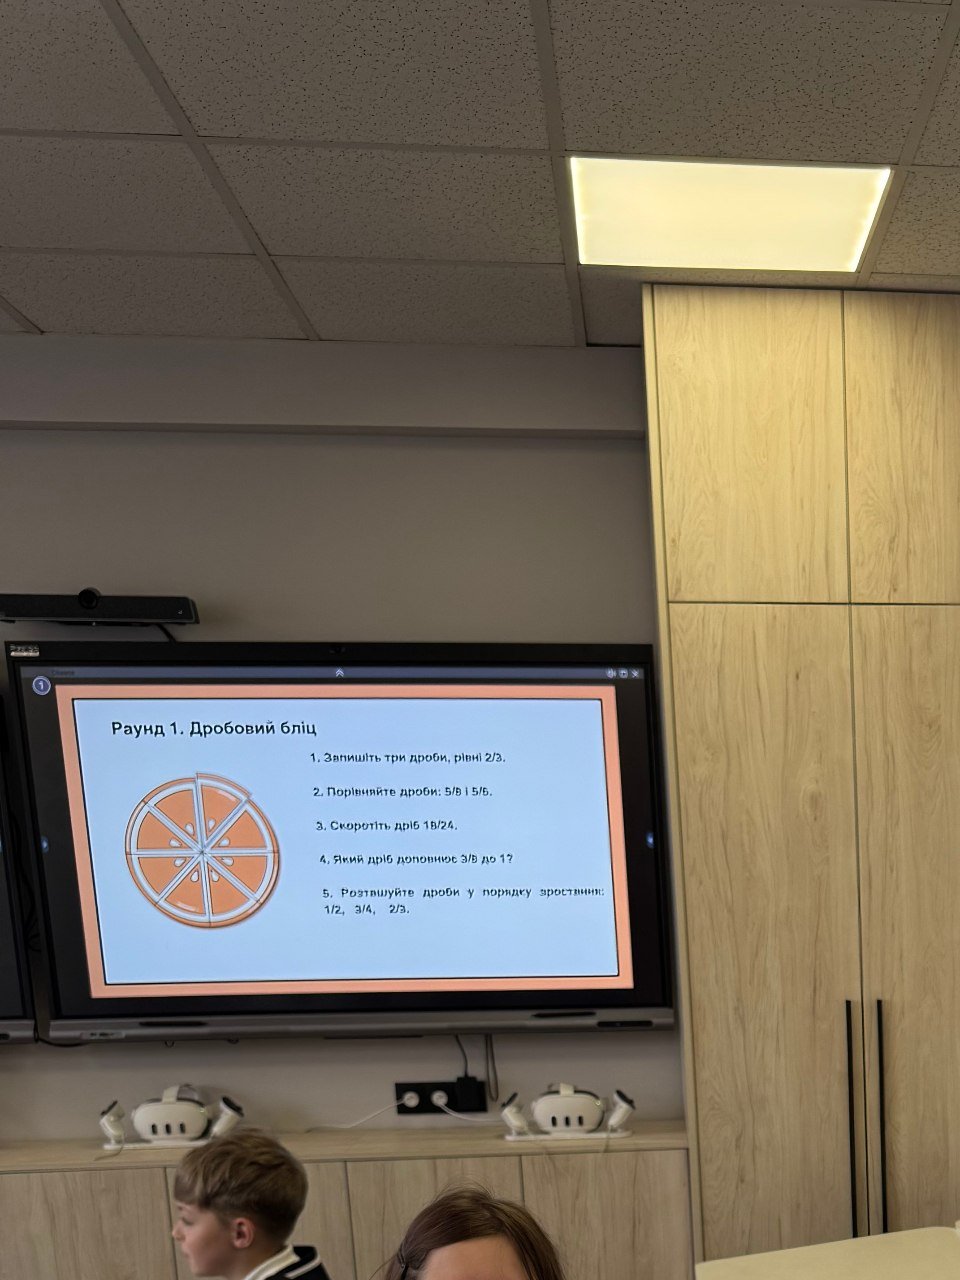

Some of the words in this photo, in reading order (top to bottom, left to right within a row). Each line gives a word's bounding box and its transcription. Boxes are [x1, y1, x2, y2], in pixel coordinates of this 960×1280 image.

[111, 721, 165, 738] Раунд
[170, 721, 184, 735] 1.
[190, 719, 275, 738] Дробовий
[281, 720, 317, 737] бліц
[310, 752, 321, 763] 1.
[324, 752, 381, 763] Запишіть
[384, 753, 406, 764] три
[409, 752, 451, 764] дроби,
[454, 752, 482, 764] рівні
[485, 752, 506, 763] 2/3.
[313, 787, 323, 797] 2.
[327, 786, 396, 798] Порівняйте
[399, 786, 442, 798] дроби:
[316, 821, 327, 831] 3.
[330, 820, 391, 832] Скоротіть
[394, 820, 420, 832] дріб
[319, 854, 330, 865] 4.
[333, 853, 364, 864] Який
[367, 854, 393, 866] дріб
[481, 854, 496, 865] до
[500, 853, 514, 864] 1?
[322, 888, 333, 898] 5.
[422, 887, 460, 899] дроби
[468, 889, 475, 899] у
[324, 905, 345, 916] 1/2,
[354, 904, 376, 915] 3/4,
[389, 904, 410, 914] 2/3.
